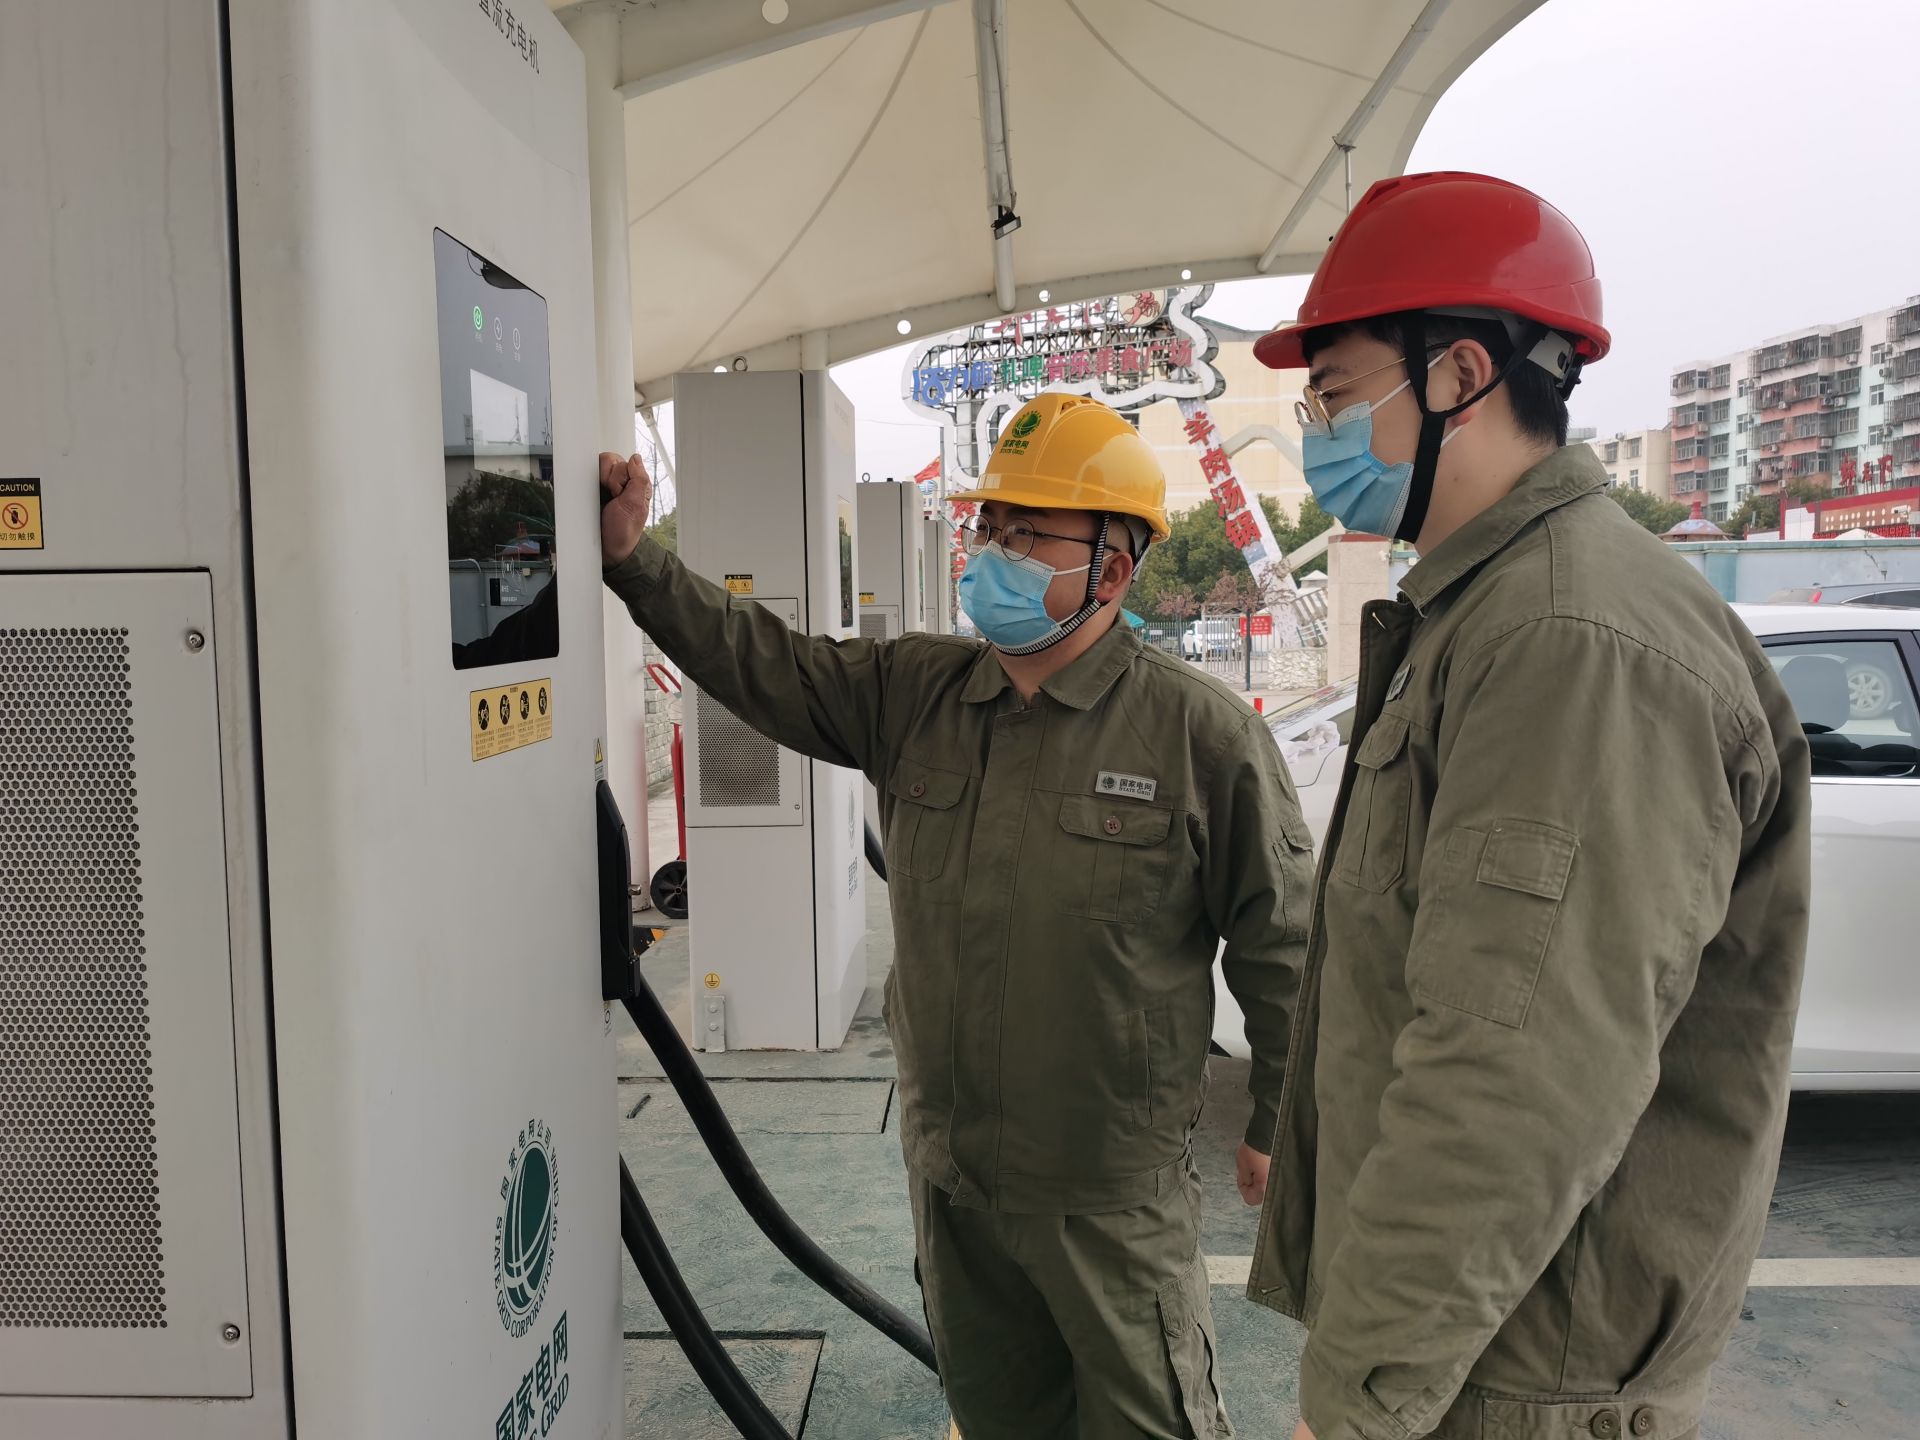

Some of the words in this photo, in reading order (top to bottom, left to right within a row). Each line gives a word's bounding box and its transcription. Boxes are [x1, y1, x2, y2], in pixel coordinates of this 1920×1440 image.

[0, 483, 35, 492] CAUTION
[1183, 411, 1262, 550] 羊肉汤锅
[1120, 779, 1153, 792] 国家电网
[501, 1118, 552, 1200] 国家电网公司
[494, 1216, 503, 1289] STATE
[497, 1290, 512, 1331] GRID
[510, 1248, 555, 1339] CORPORATION
[541, 1372, 569, 1438] GRID
